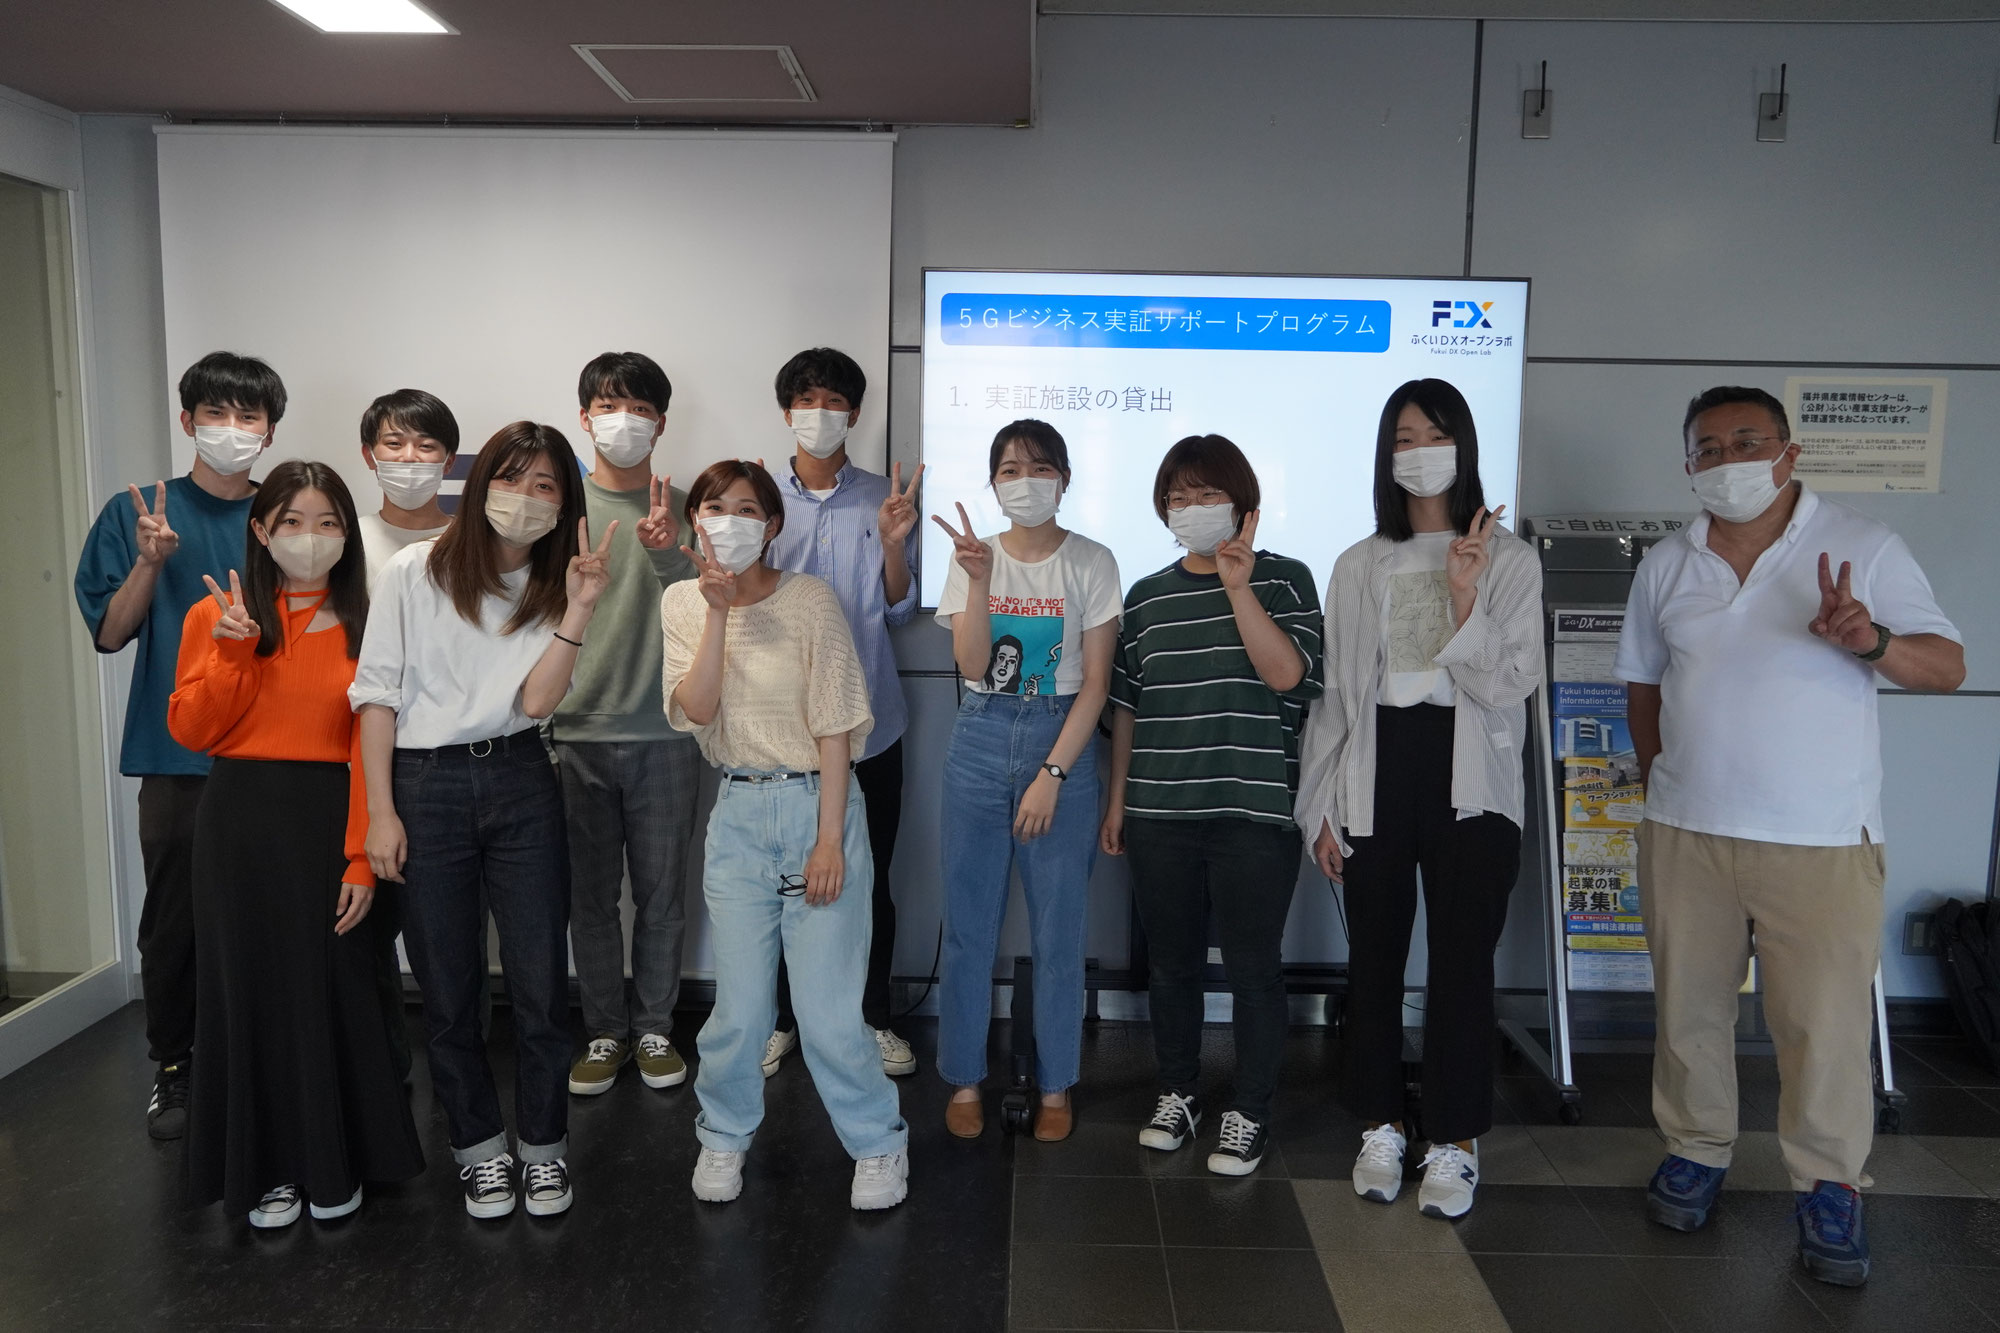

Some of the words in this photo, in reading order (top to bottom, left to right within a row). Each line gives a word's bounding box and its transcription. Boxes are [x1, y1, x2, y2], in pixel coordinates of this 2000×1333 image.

[959, 308, 1376, 336] 5Gビジネス実証サポートプログラム
[1411, 335, 1513, 347] ふくいDXオープンラボ
[949, 385, 969, 407] 1.
[985, 384, 1172, 412] 実証施設の貸出
[1801, 392, 1910, 402] 福井県産業情報センターは、
[1800, 403, 1928, 414] (公財)ふくい産業支援センターが
[1800, 414, 1911, 425] 管理運営をおこなっています。
[1545, 518, 1688, 532] ご自由にお取
[1005, 596, 1023, 606] NO!
[1026, 597, 1042, 607] IT'S
[1045, 598, 1065, 607] NOT
[988, 603, 1064, 616] CIGARETTE
[1560, 687, 1581, 695] Fukui
[1584, 687, 1621, 696] Industrial
[1560, 696, 1605, 705] Information
[1607, 697, 1628, 705] Cente
[1568, 877, 1622, 890] 起業の種
[1568, 890, 1618, 912] 募集!
[1592, 922, 1643, 932] 無料法律相談
